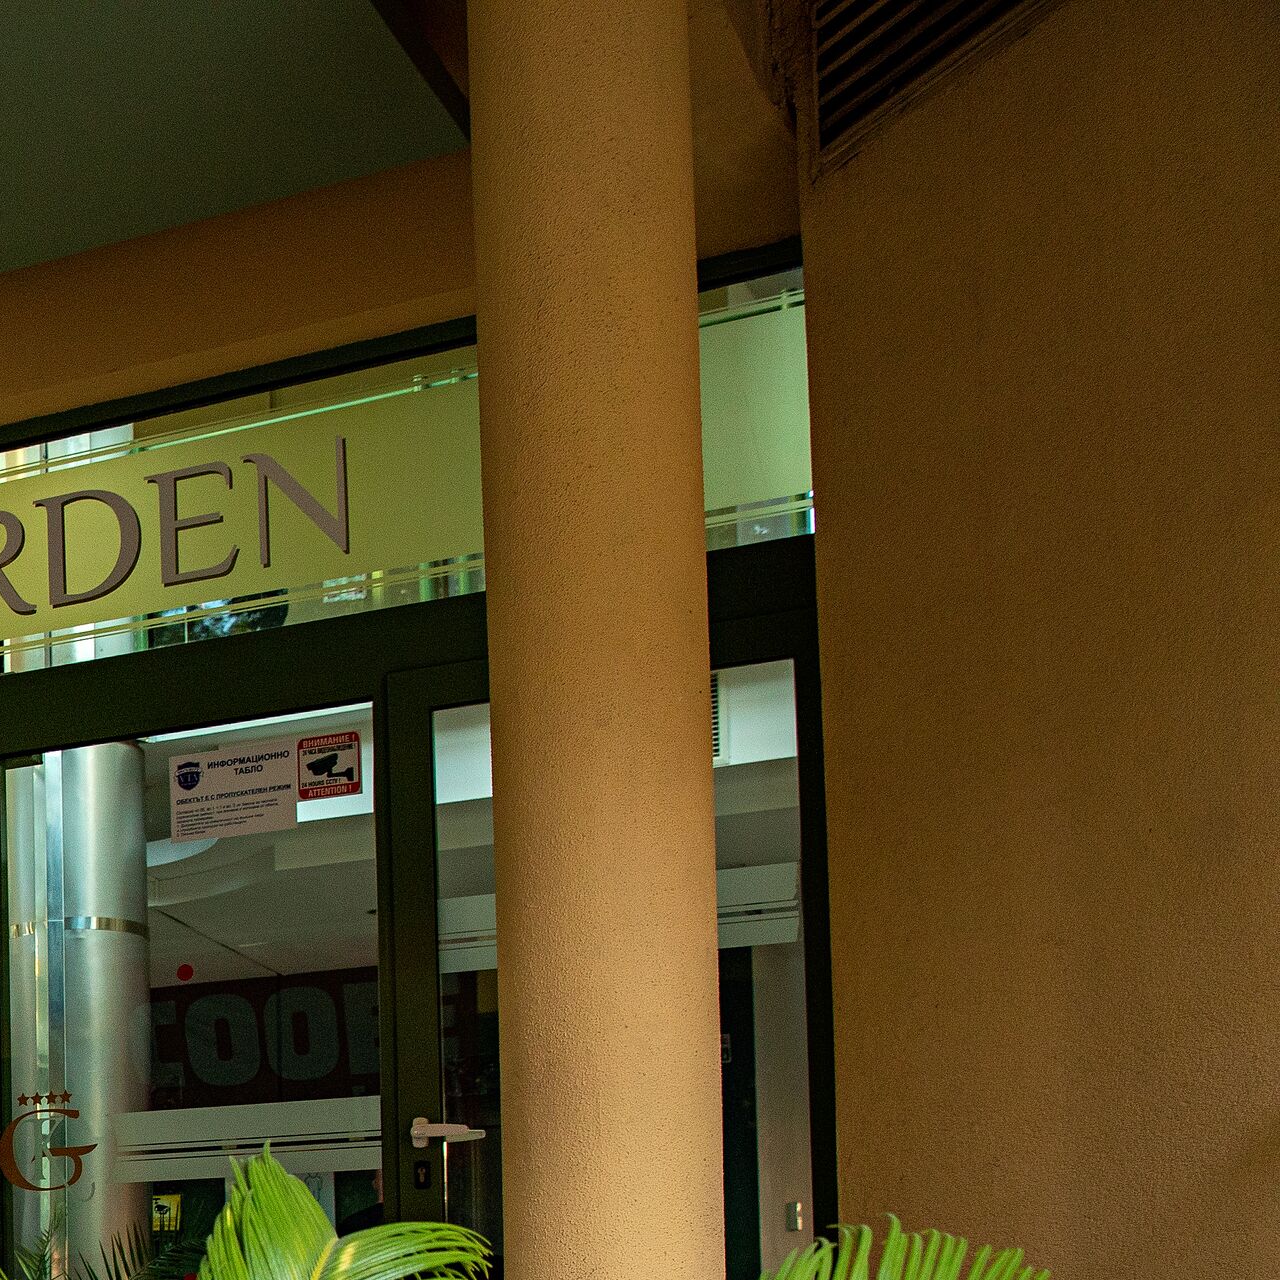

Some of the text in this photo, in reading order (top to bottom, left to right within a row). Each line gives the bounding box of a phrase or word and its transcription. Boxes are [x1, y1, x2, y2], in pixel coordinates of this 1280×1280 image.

[302, 734, 350, 748] ВНИМАНИЕ
[207, 750, 290, 770] ИНФОРМАЦИОННО
[233, 764, 264, 776] ТАБЛО
[308, 784, 347, 798] ATTENTION
